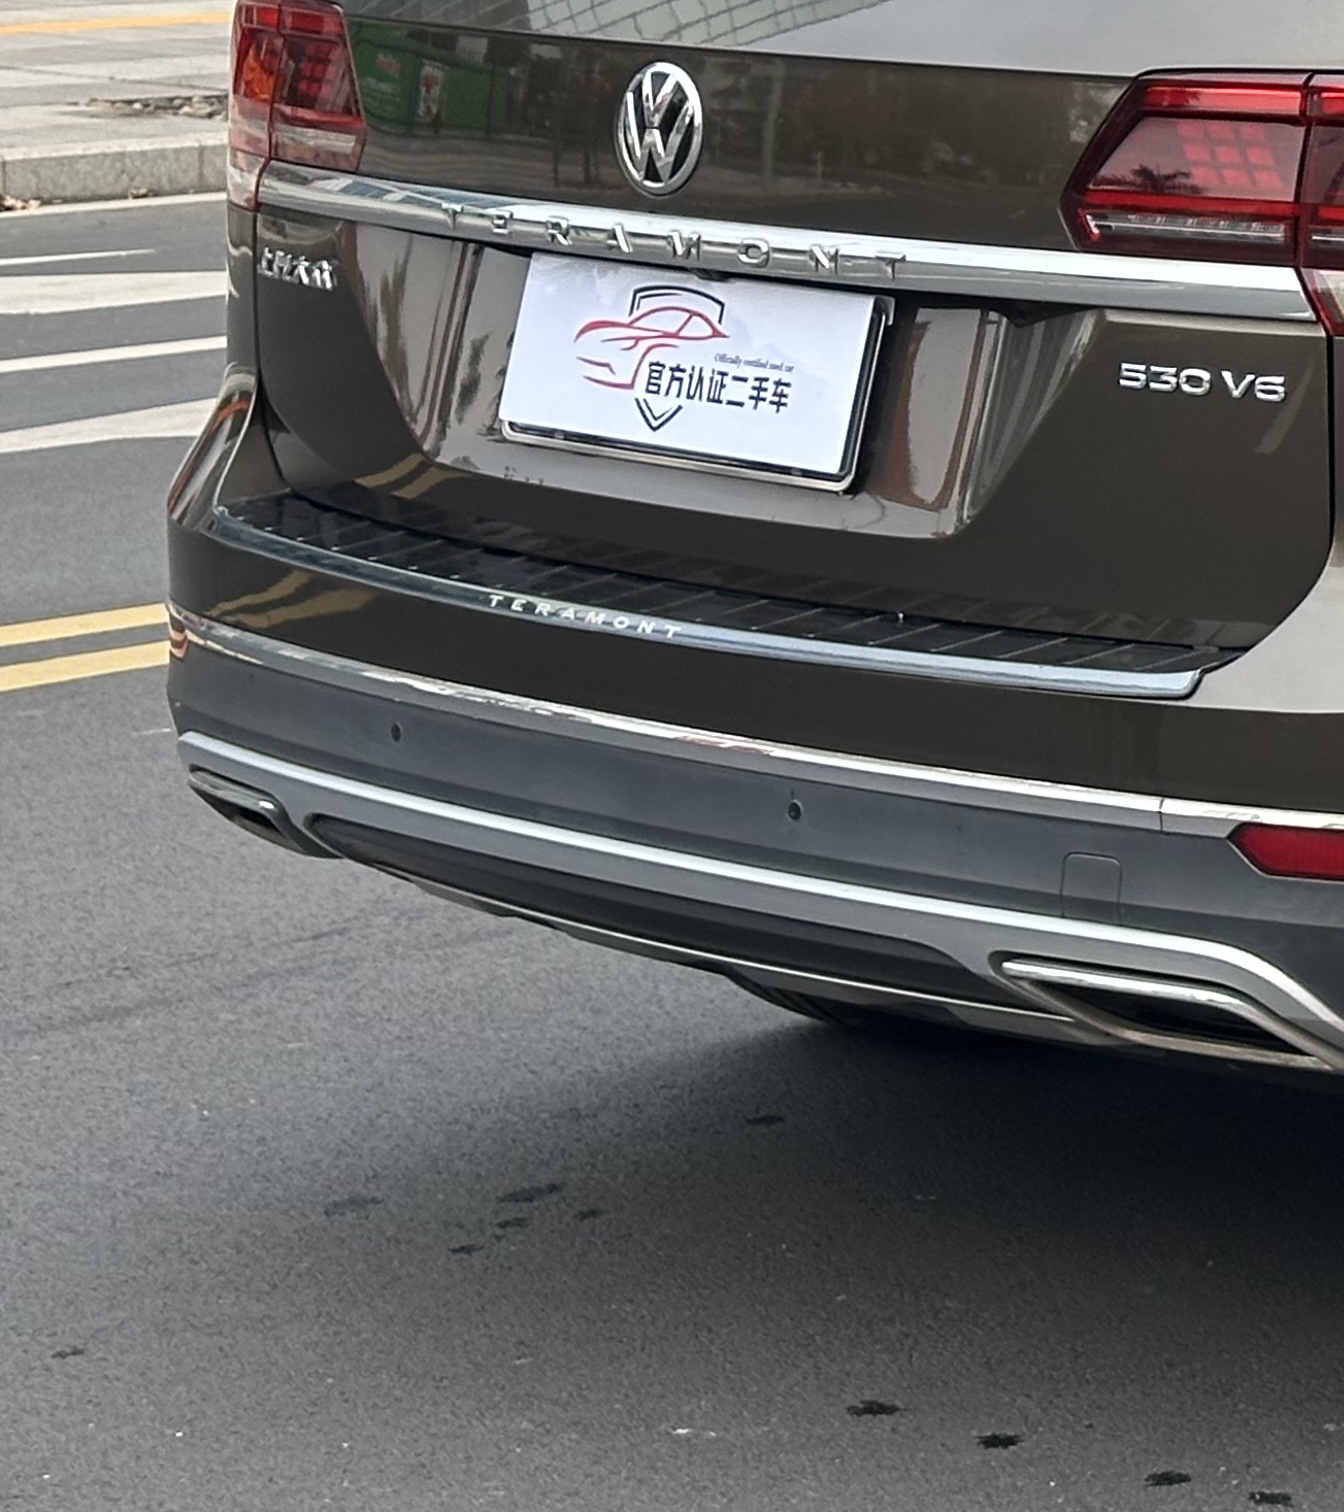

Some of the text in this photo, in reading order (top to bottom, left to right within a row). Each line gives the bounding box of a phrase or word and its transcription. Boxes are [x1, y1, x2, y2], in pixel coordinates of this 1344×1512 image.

[439, 201, 907, 281] TERAMONT
[645, 360, 792, 414] 官方认证二手车
[1119, 362, 1286, 402] 530 V6
[488, 593, 681, 639] TERAMONT
